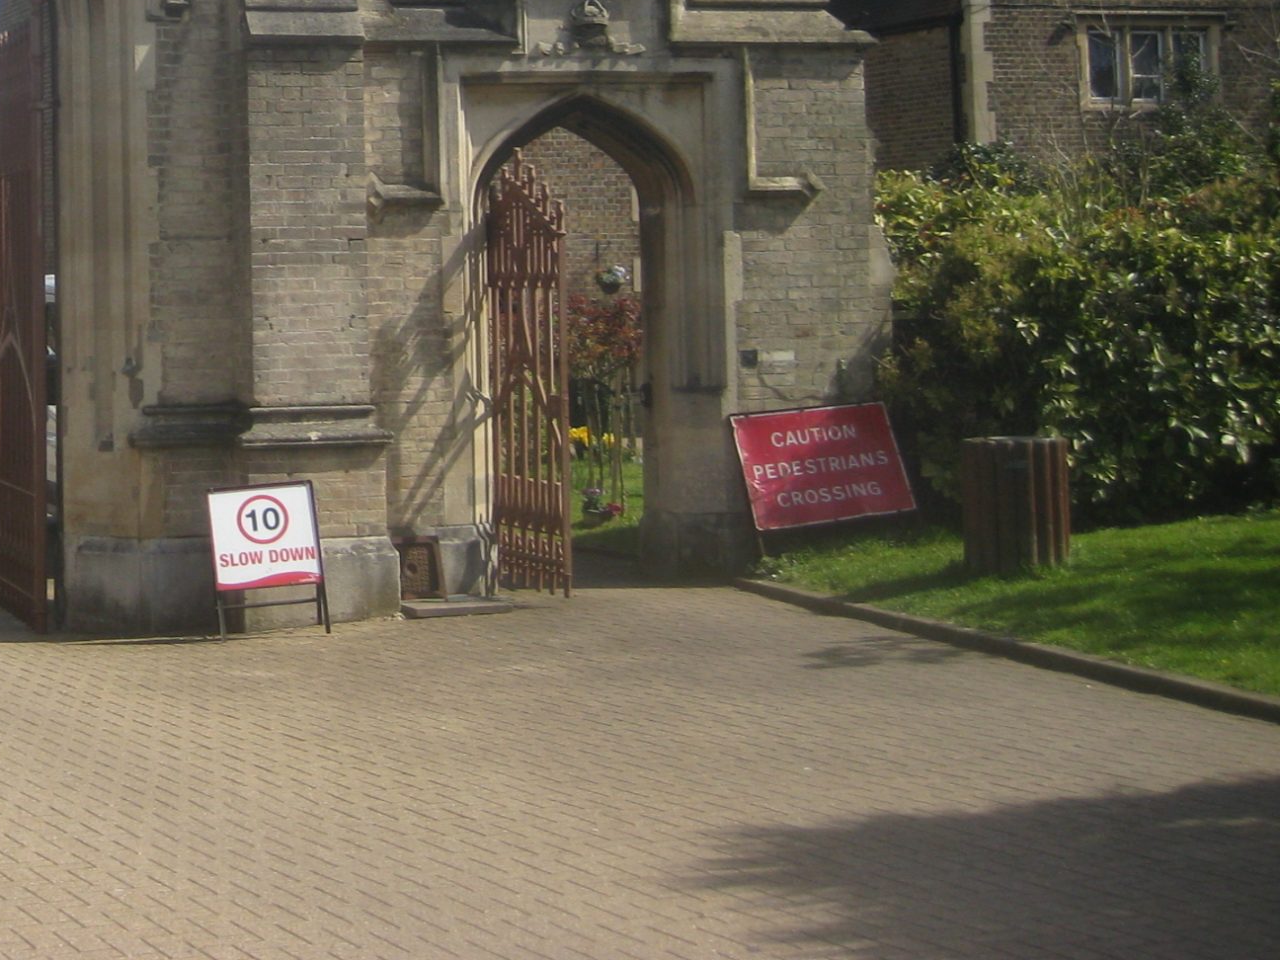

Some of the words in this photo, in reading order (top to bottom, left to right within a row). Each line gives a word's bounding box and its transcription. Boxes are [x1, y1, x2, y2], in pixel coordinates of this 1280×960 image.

[770, 424, 856, 448] CAUTION
[753, 450, 889, 480] PEDESTRIANS
[777, 481, 882, 508] CROSSING
[245, 507, 280, 532] 10
[219, 550, 263, 568] SLOW
[269, 546, 316, 563] DOWN
